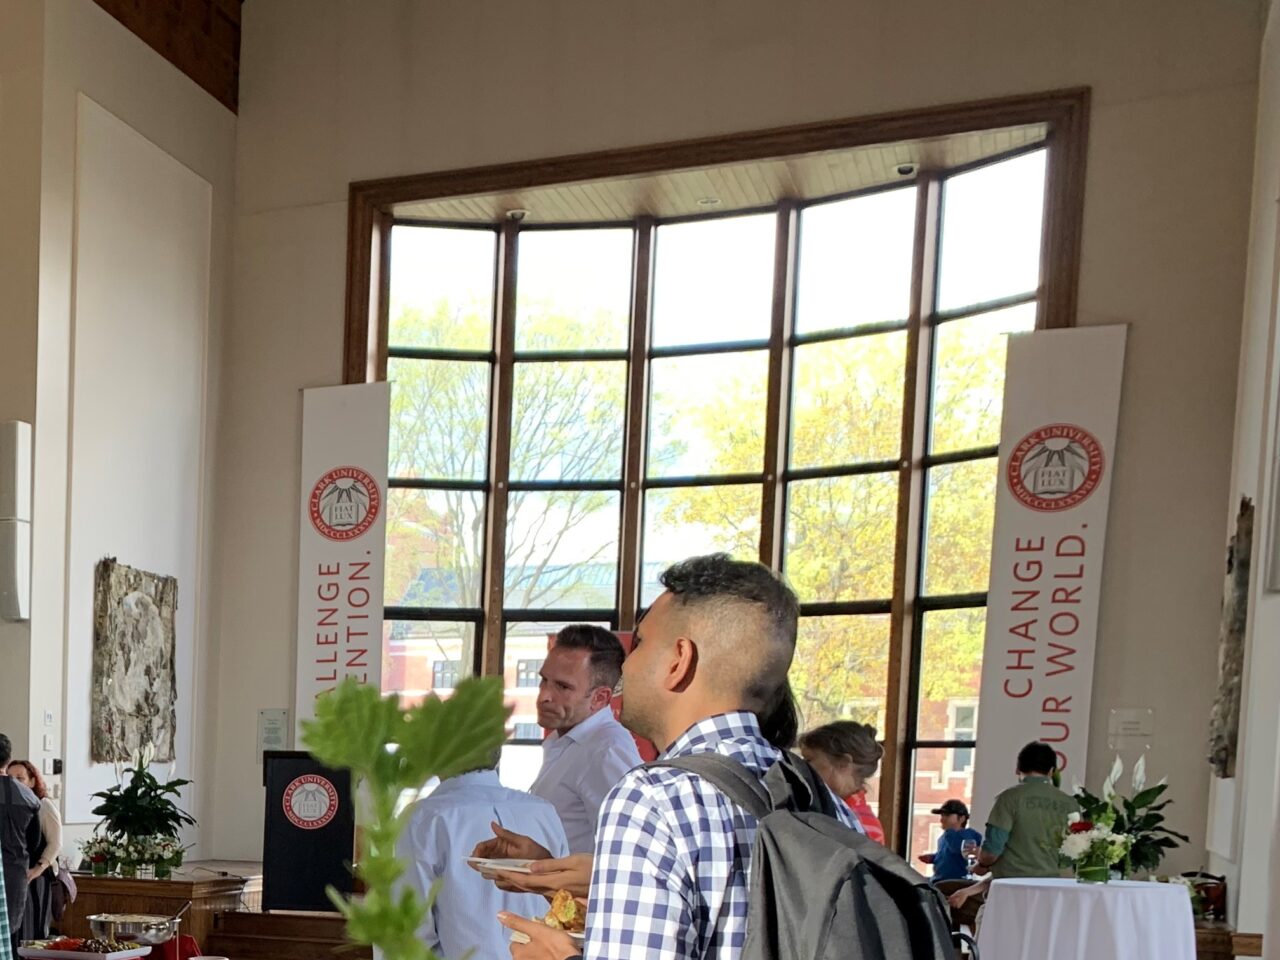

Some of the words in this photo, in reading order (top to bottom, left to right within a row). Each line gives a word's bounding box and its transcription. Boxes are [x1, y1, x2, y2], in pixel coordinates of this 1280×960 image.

[1011, 437, 1039, 475] CLARK
[1041, 427, 1100, 470] UNIVERSITY
[311, 475, 331, 511] CLARK
[332, 469, 378, 507] UNIVERSITY
[1004, 536, 1045, 698] CHANGE
[1045, 523, 1088, 677] WORLD.
[286, 781, 301, 806] CLARK
[301, 777, 336, 804] UNIVERSITY
